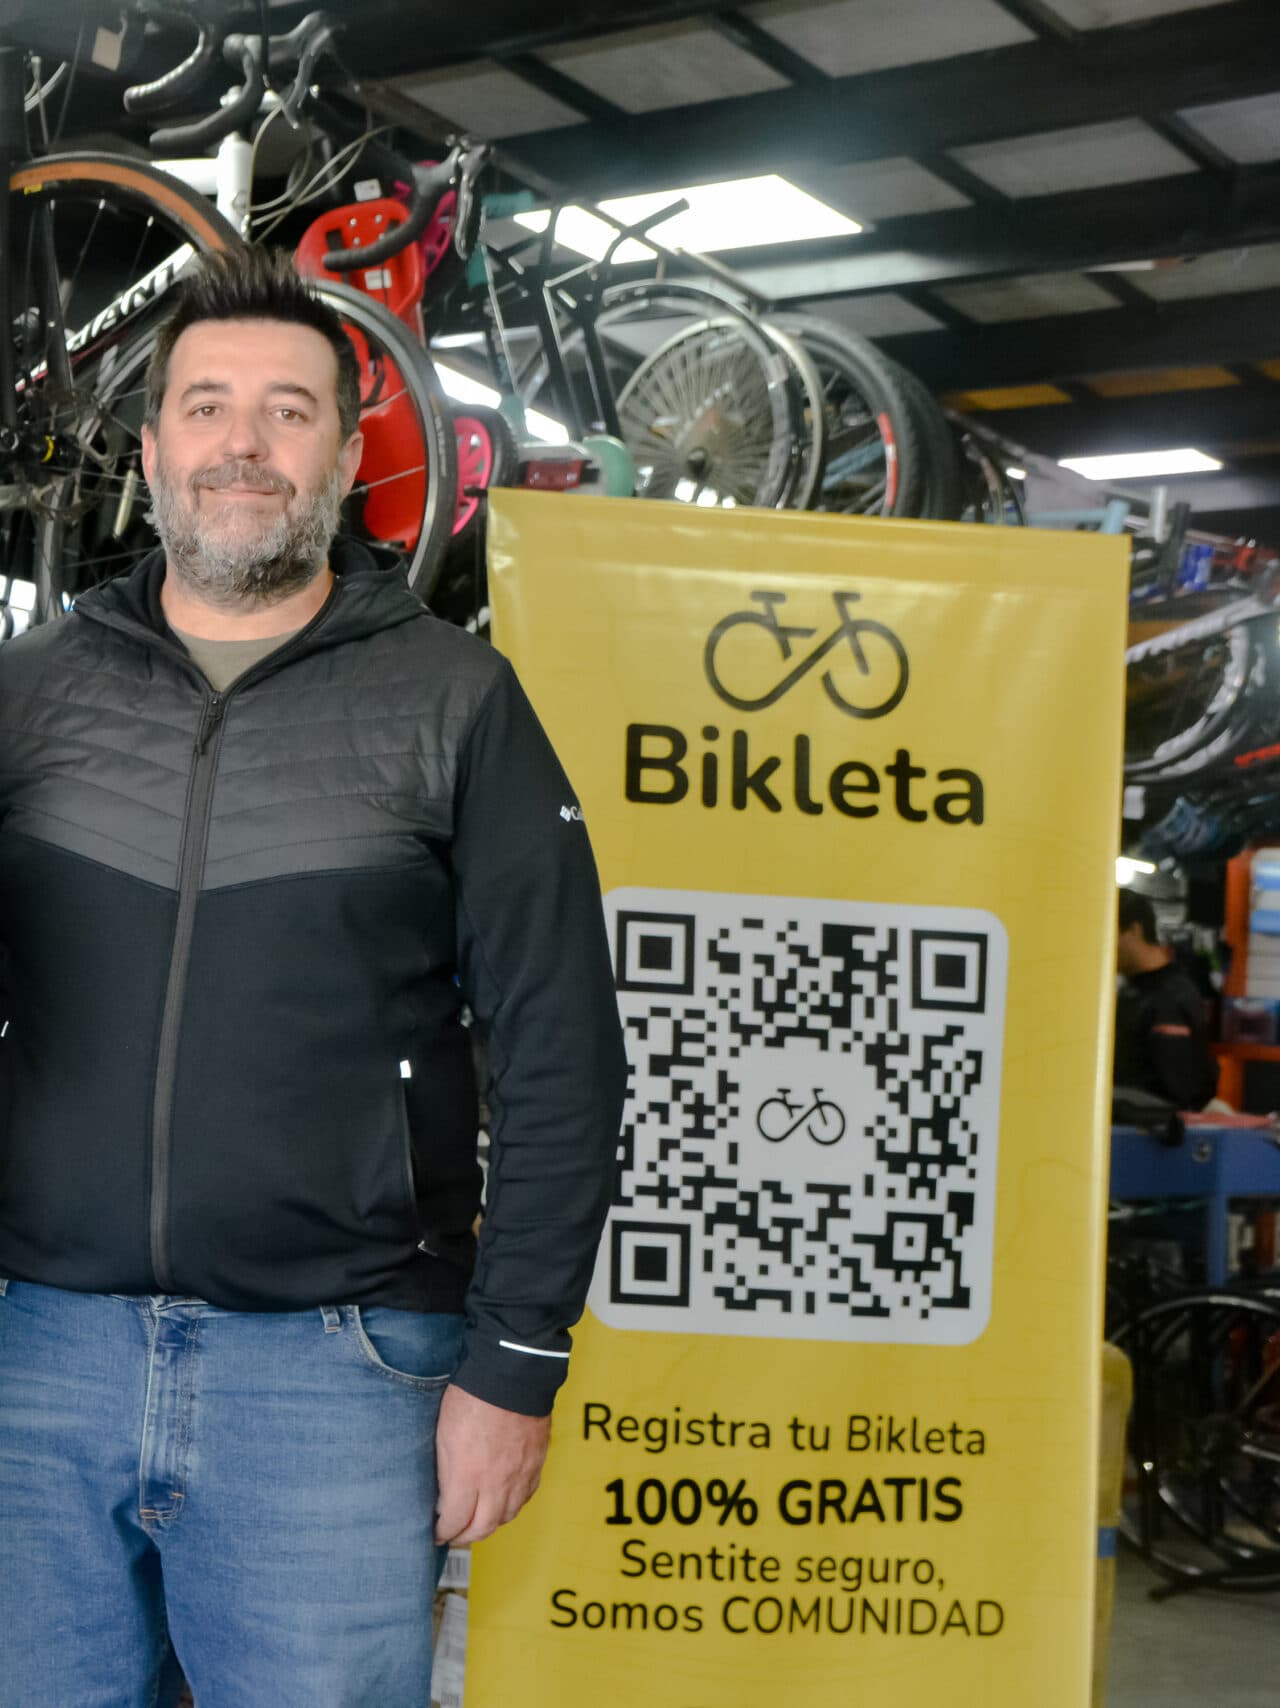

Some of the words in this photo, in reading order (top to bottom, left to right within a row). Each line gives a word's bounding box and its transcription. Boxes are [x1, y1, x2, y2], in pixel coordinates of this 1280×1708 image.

[625, 723, 984, 826] Bikleta
[583, 1402, 772, 1454] Registra
[788, 1416, 831, 1452] tu
[847, 1414, 987, 1456] Bikleta
[604, 1477, 759, 1526] 100%
[777, 1476, 965, 1526] GRATIS
[620, 1538, 781, 1583] Sentite
[795, 1555, 946, 1592] seguro,
[550, 1588, 704, 1634] Somos
[722, 1596, 1006, 1638] COMUNIDAD
